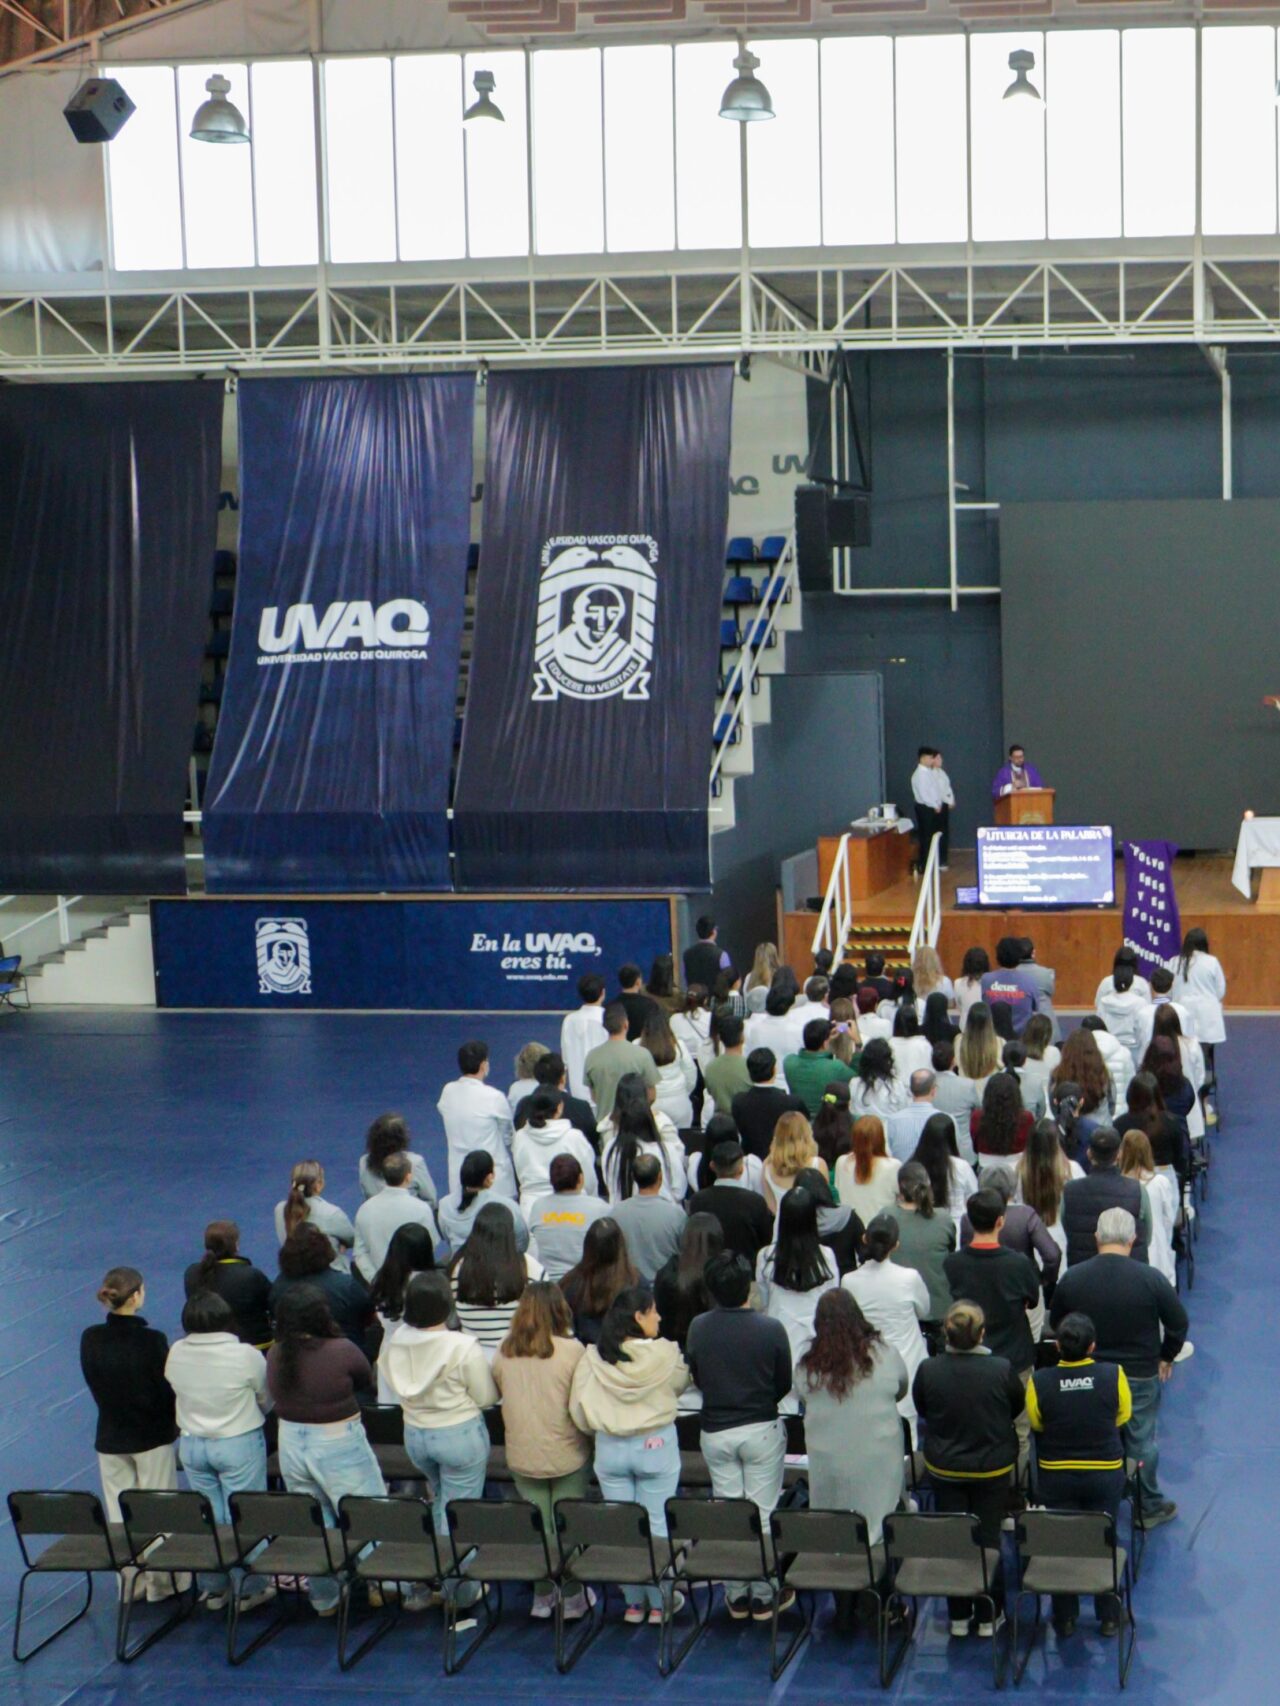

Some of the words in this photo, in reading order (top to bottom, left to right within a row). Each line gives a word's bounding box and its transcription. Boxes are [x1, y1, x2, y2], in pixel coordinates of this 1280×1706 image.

[772, 454, 809, 475] UV
[541, 536, 586, 566] UNIVERSIDAD
[587, 535, 616, 545] VASCO
[616, 535, 628, 544] DE
[629, 534, 659, 563] QUIROGA
[258, 598, 430, 653] UVAQ
[257, 652, 322, 666] UNIVERSIDAD
[323, 651, 357, 661] VASCO
[360, 651, 374, 660] DE
[375, 649, 428, 660] QUIROGA
[548, 663, 584, 692] EDUCERE
[584, 684, 595, 693] IN
[597, 660, 637, 692] VERITATE
[986, 831, 1029, 841] LITURGIA
[1030, 830, 1044, 840] DE
[1046, 830, 1060, 840] LA
[1061, 830, 1102, 840] PALABRA
[1139, 872, 1165, 893] ERES
[1137, 891, 1145, 901] Y
[1151, 896, 1166, 911] EN
[1132, 907, 1171, 933] POLVO
[470, 933, 499, 952] En
[501, 933, 521, 952] la
[525, 932, 602, 956] UVAQ,
[1147, 931, 1159, 946] TE
[500, 956, 542, 969] eres
[545, 951, 572, 969] tú.
[1060, 1377, 1094, 1388] UVAQ
